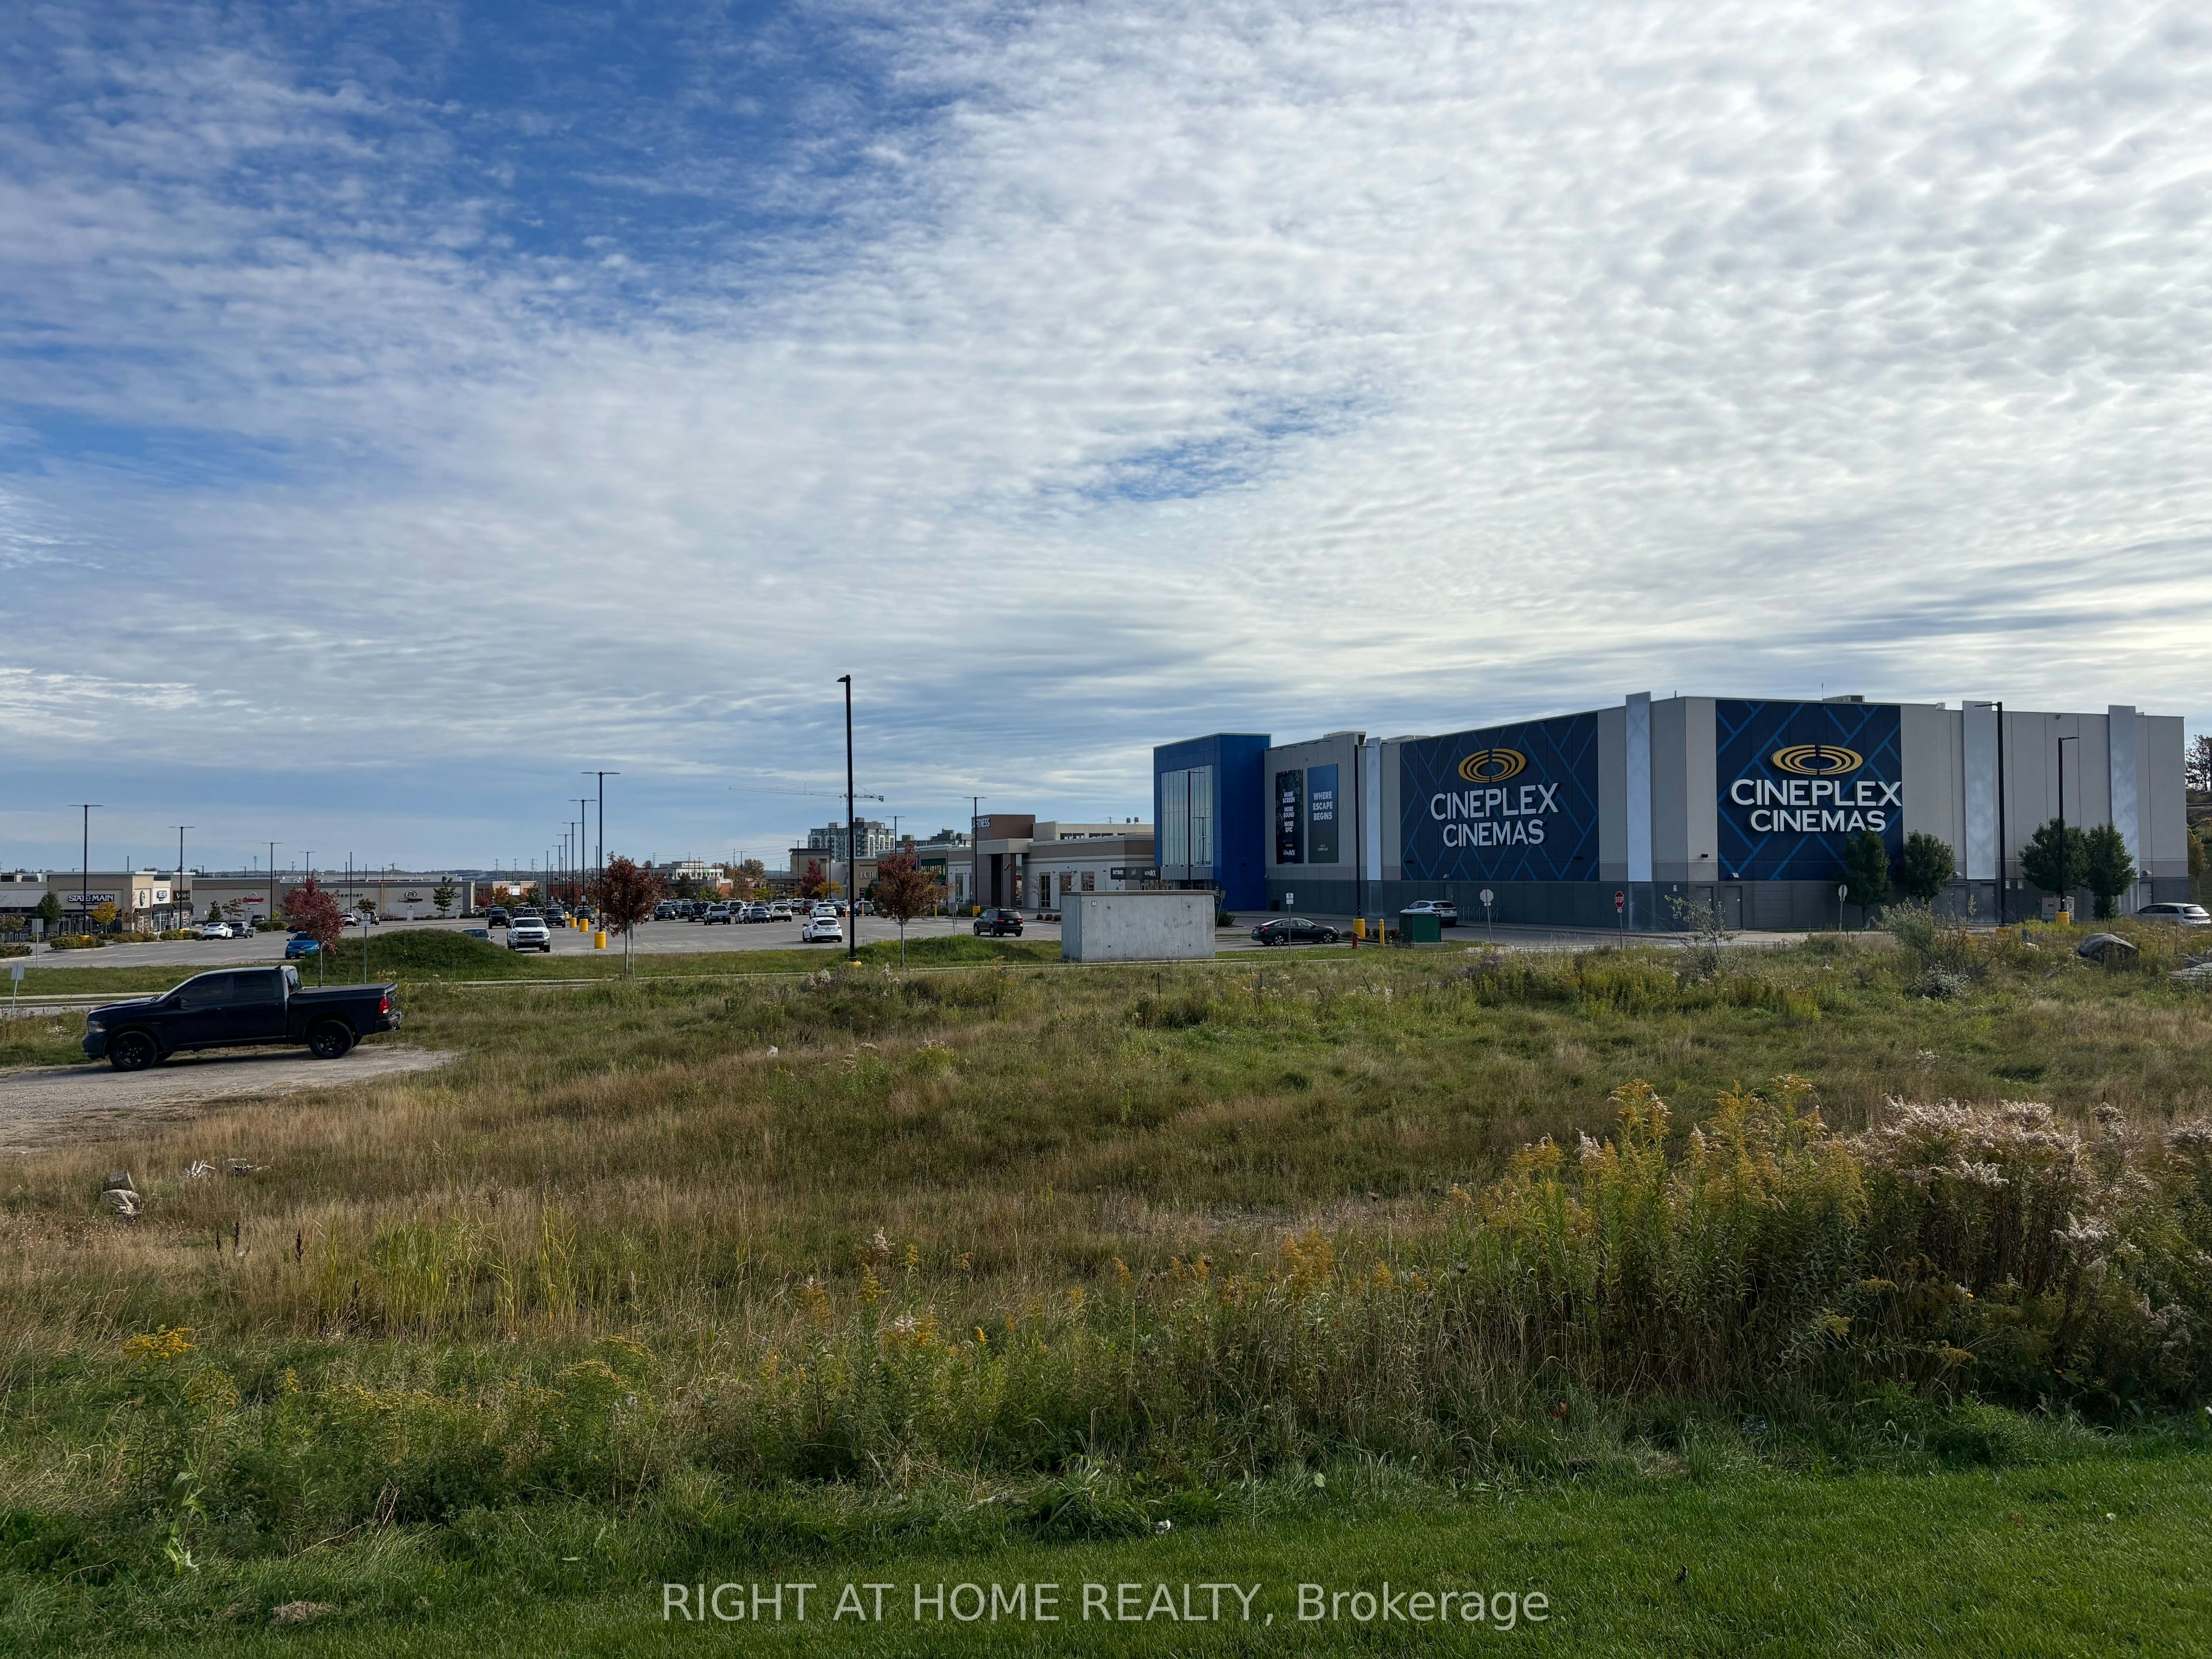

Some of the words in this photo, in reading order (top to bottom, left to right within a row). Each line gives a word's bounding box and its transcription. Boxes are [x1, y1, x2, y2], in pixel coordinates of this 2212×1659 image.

[1313, 791, 1332, 800] WHERE
[1430, 782, 1559, 820] CINEPLEX
[1730, 779, 1903, 806] CINEPLEX
[1313, 801, 1333, 810] ESCAPE
[1313, 812, 1332, 821] BEGINS
[1749, 809, 1887, 832] CINEMAS
[1443, 819, 1545, 847] CINEMAS
